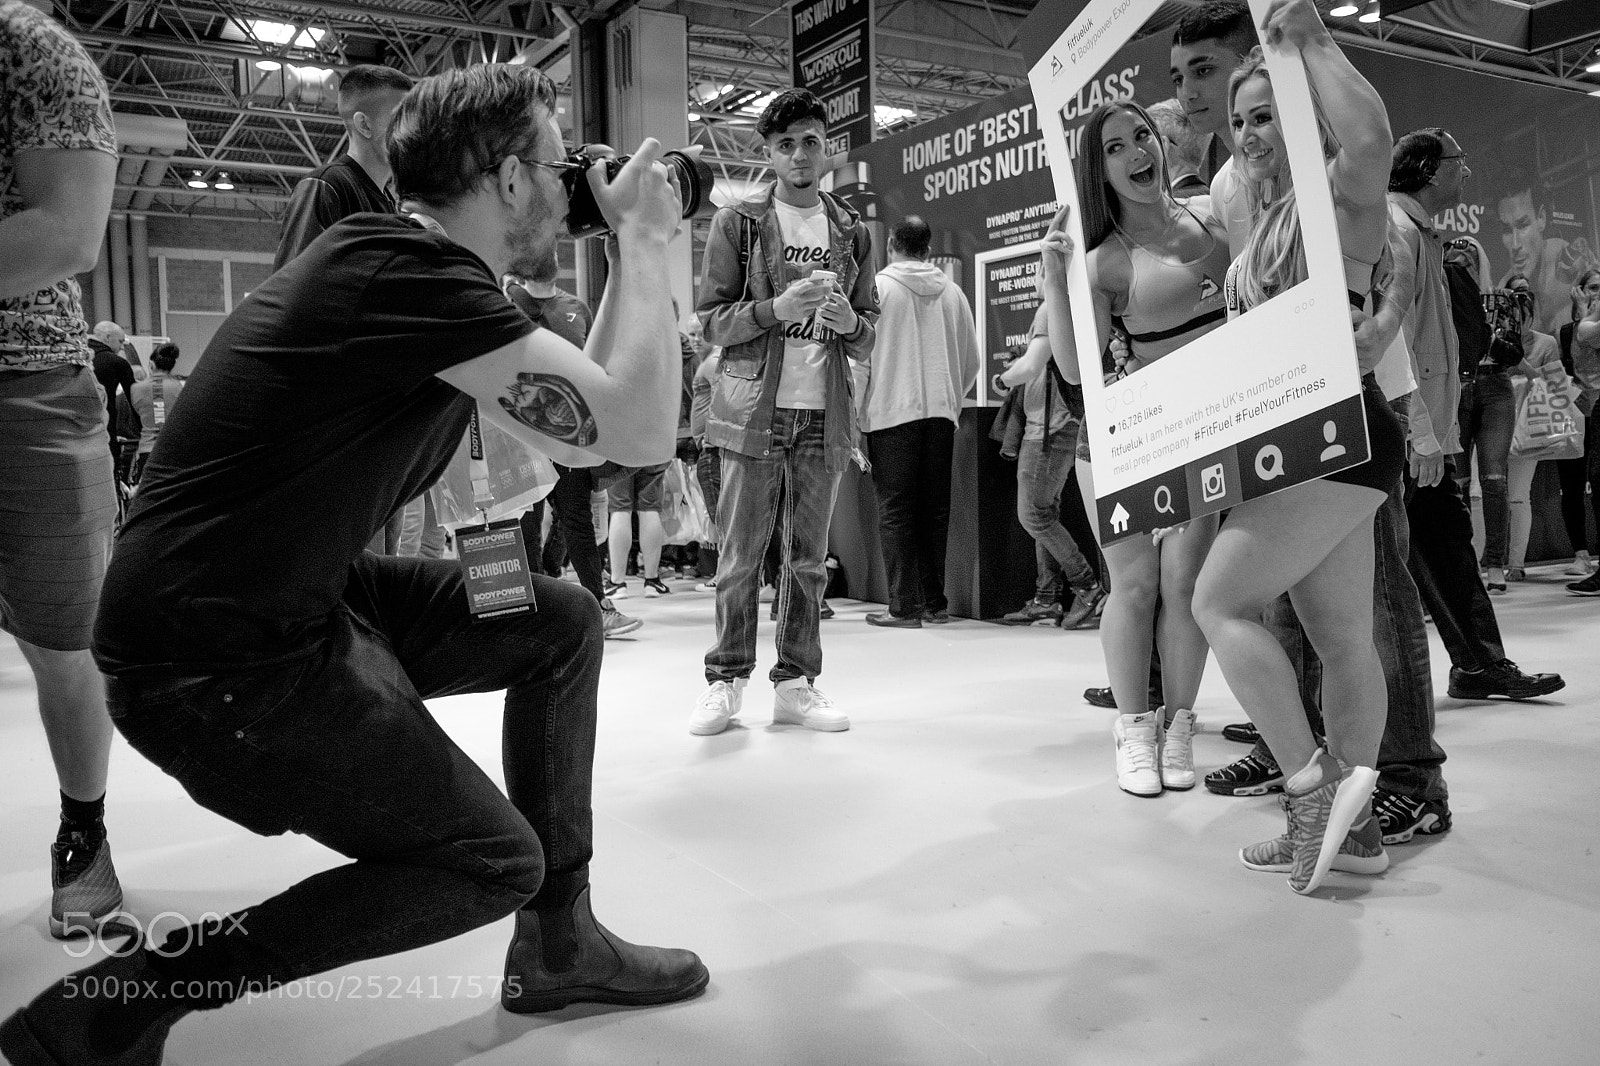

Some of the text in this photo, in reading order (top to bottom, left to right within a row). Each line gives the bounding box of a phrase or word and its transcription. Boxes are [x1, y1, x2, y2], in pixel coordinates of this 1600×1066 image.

[794, 6, 814, 36] THIS
[1067, 18, 1094, 51] fitfueluk
[1078, 17, 1114, 59] Bodypower
[804, 39, 862, 82] WORKOUT
[829, 87, 861, 124] COURT
[902, 133, 951, 175] HOME
[954, 123, 977, 157] OF
[978, 103, 1033, 148] 'BEST
[923, 156, 992, 202] SPORTS
[1431, 202, 1485, 235] LASS'
[1005, 333, 1029, 347] DYNA
[1111, 436, 1144, 459] fitfueluk
[1150, 429, 1163, 442] am
[1164, 420, 1183, 435] here
[1185, 409, 1204, 425] with
[1205, 402, 1221, 417] the
[1222, 391, 1245, 409] UK's
[1247, 373, 1285, 399] number
[1287, 363, 1307, 380] one
[1113, 377, 1326, 475] meal prep company #FitFuel #FuelYourFitness
[1118, 404, 1163, 432] 16,726 likes
[1527, 393, 1552, 439] LIFE
[462, 531, 516, 548] BODYPOWER
[468, 558, 522, 580] EXHIBITOR
[473, 586, 526, 602] BODYPOWER
